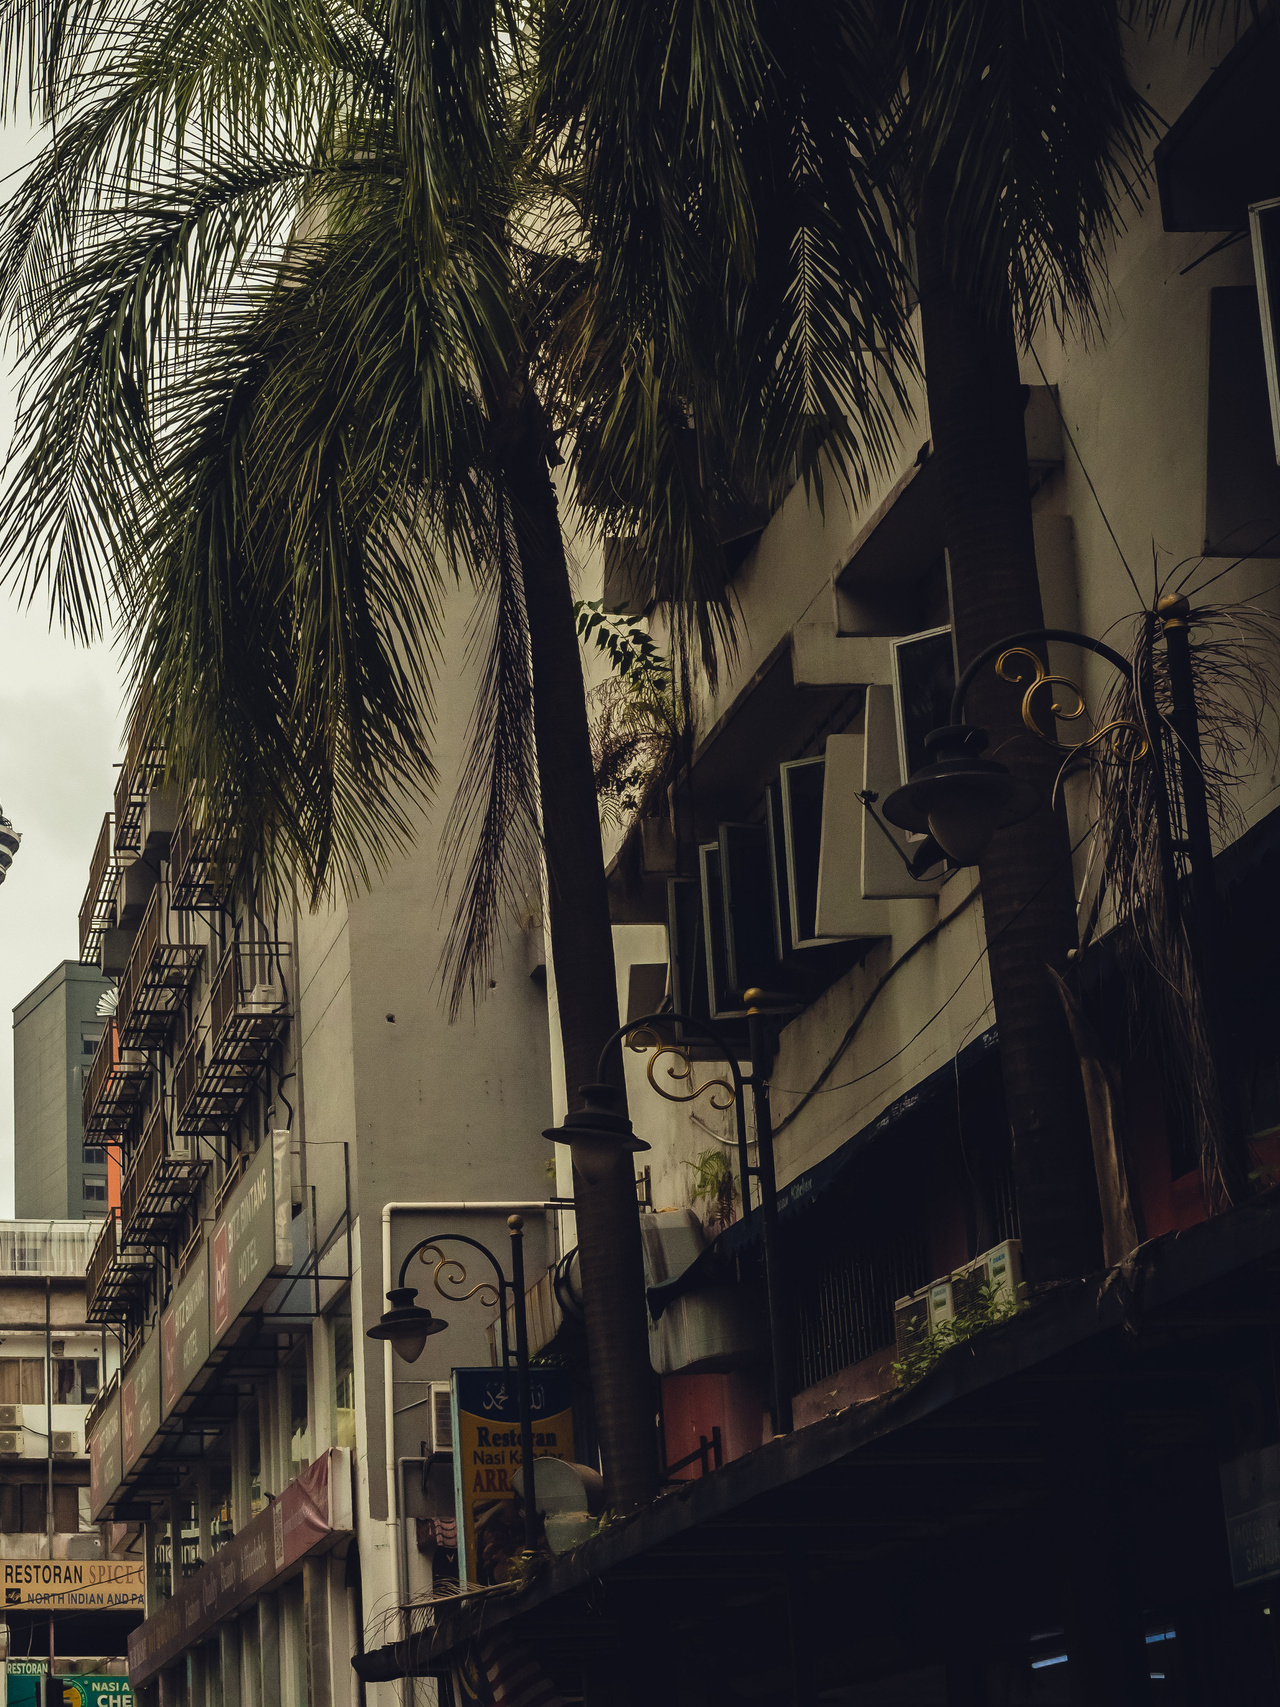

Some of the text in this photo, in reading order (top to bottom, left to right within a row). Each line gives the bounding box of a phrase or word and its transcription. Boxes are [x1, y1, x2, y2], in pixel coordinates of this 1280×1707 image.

[473, 1450, 505, 1465] Nasi
[472, 1468, 517, 1492] ARR
[4, 1564, 83, 1584] RESTORAN
[89, 1565, 134, 1584] SPICE
[27, 1593, 65, 1605] NORTH
[67, 1593, 104, 1605] INDIAN
[106, 1593, 129, 1604] AND
[7, 1662, 49, 1674] RESTORAN
[91, 1682, 120, 1692] NASI
